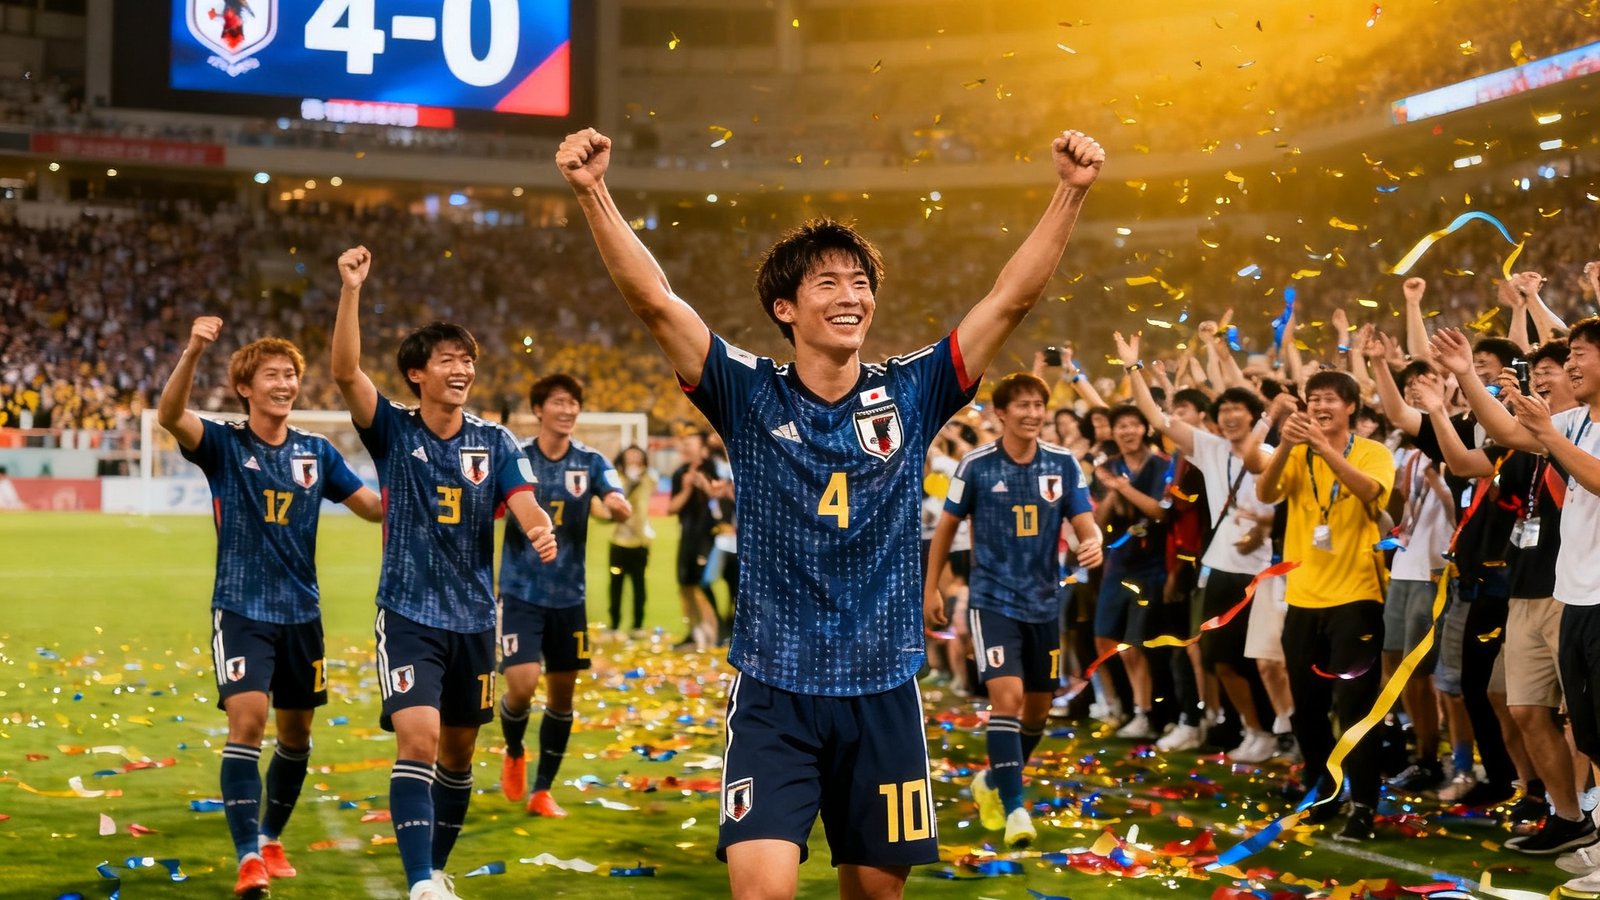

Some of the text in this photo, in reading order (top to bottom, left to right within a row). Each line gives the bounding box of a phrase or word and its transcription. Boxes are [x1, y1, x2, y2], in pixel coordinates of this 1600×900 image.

[304, 0, 520, 87] 4-0
[263, 489, 294, 525] 17
[818, 472, 850, 528] 4
[879, 779, 930, 842] 10
